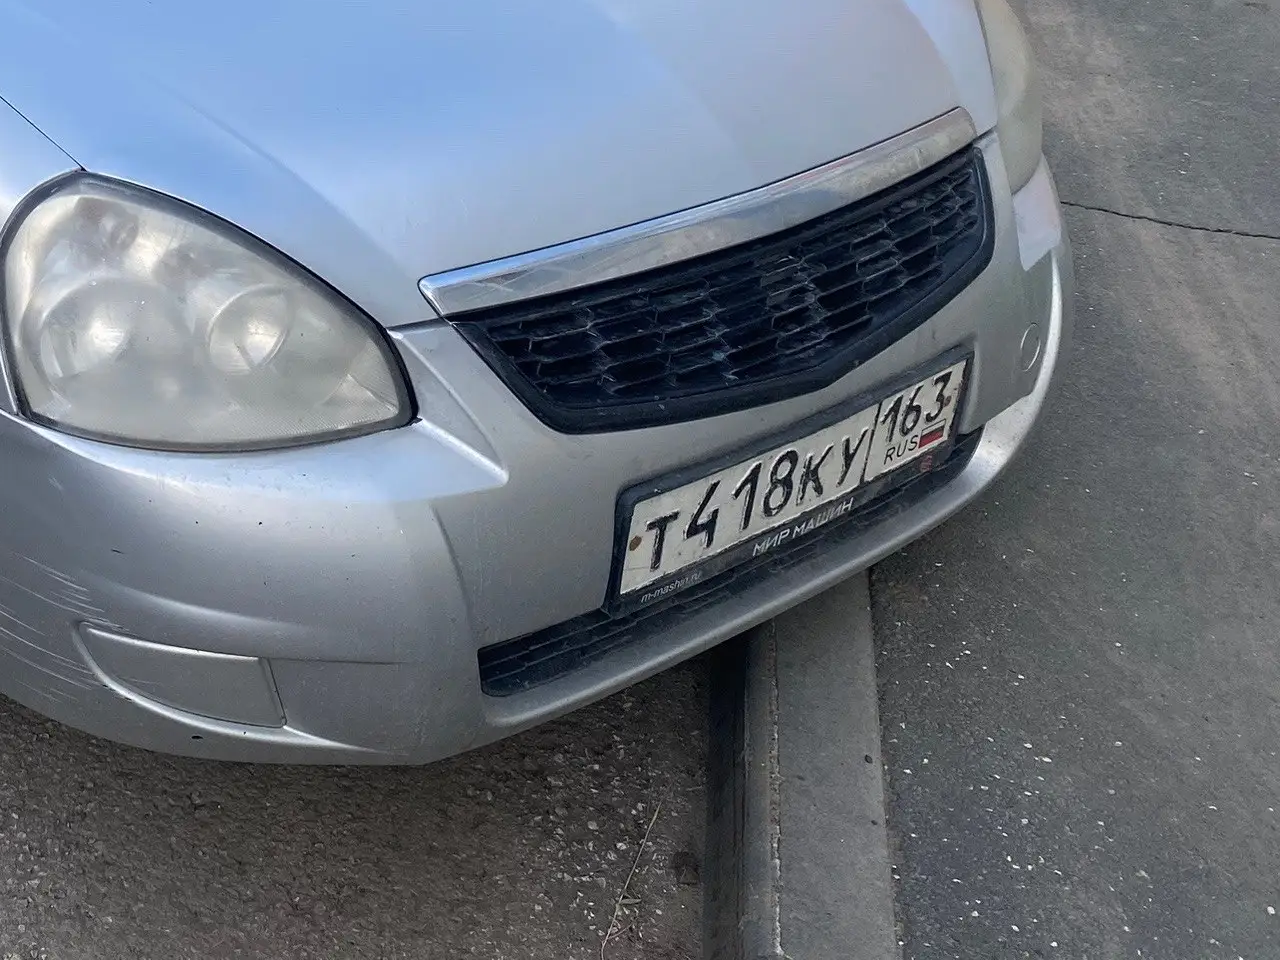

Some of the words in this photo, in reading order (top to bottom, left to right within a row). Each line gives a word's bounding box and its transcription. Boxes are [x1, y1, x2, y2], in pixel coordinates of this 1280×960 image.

[644, 427, 869, 571] Т418КУ
[880, 370, 954, 443] 163
[884, 435, 920, 465] RUS
[751, 528, 791, 557] МИР
[792, 497, 855, 539] МАШИН
